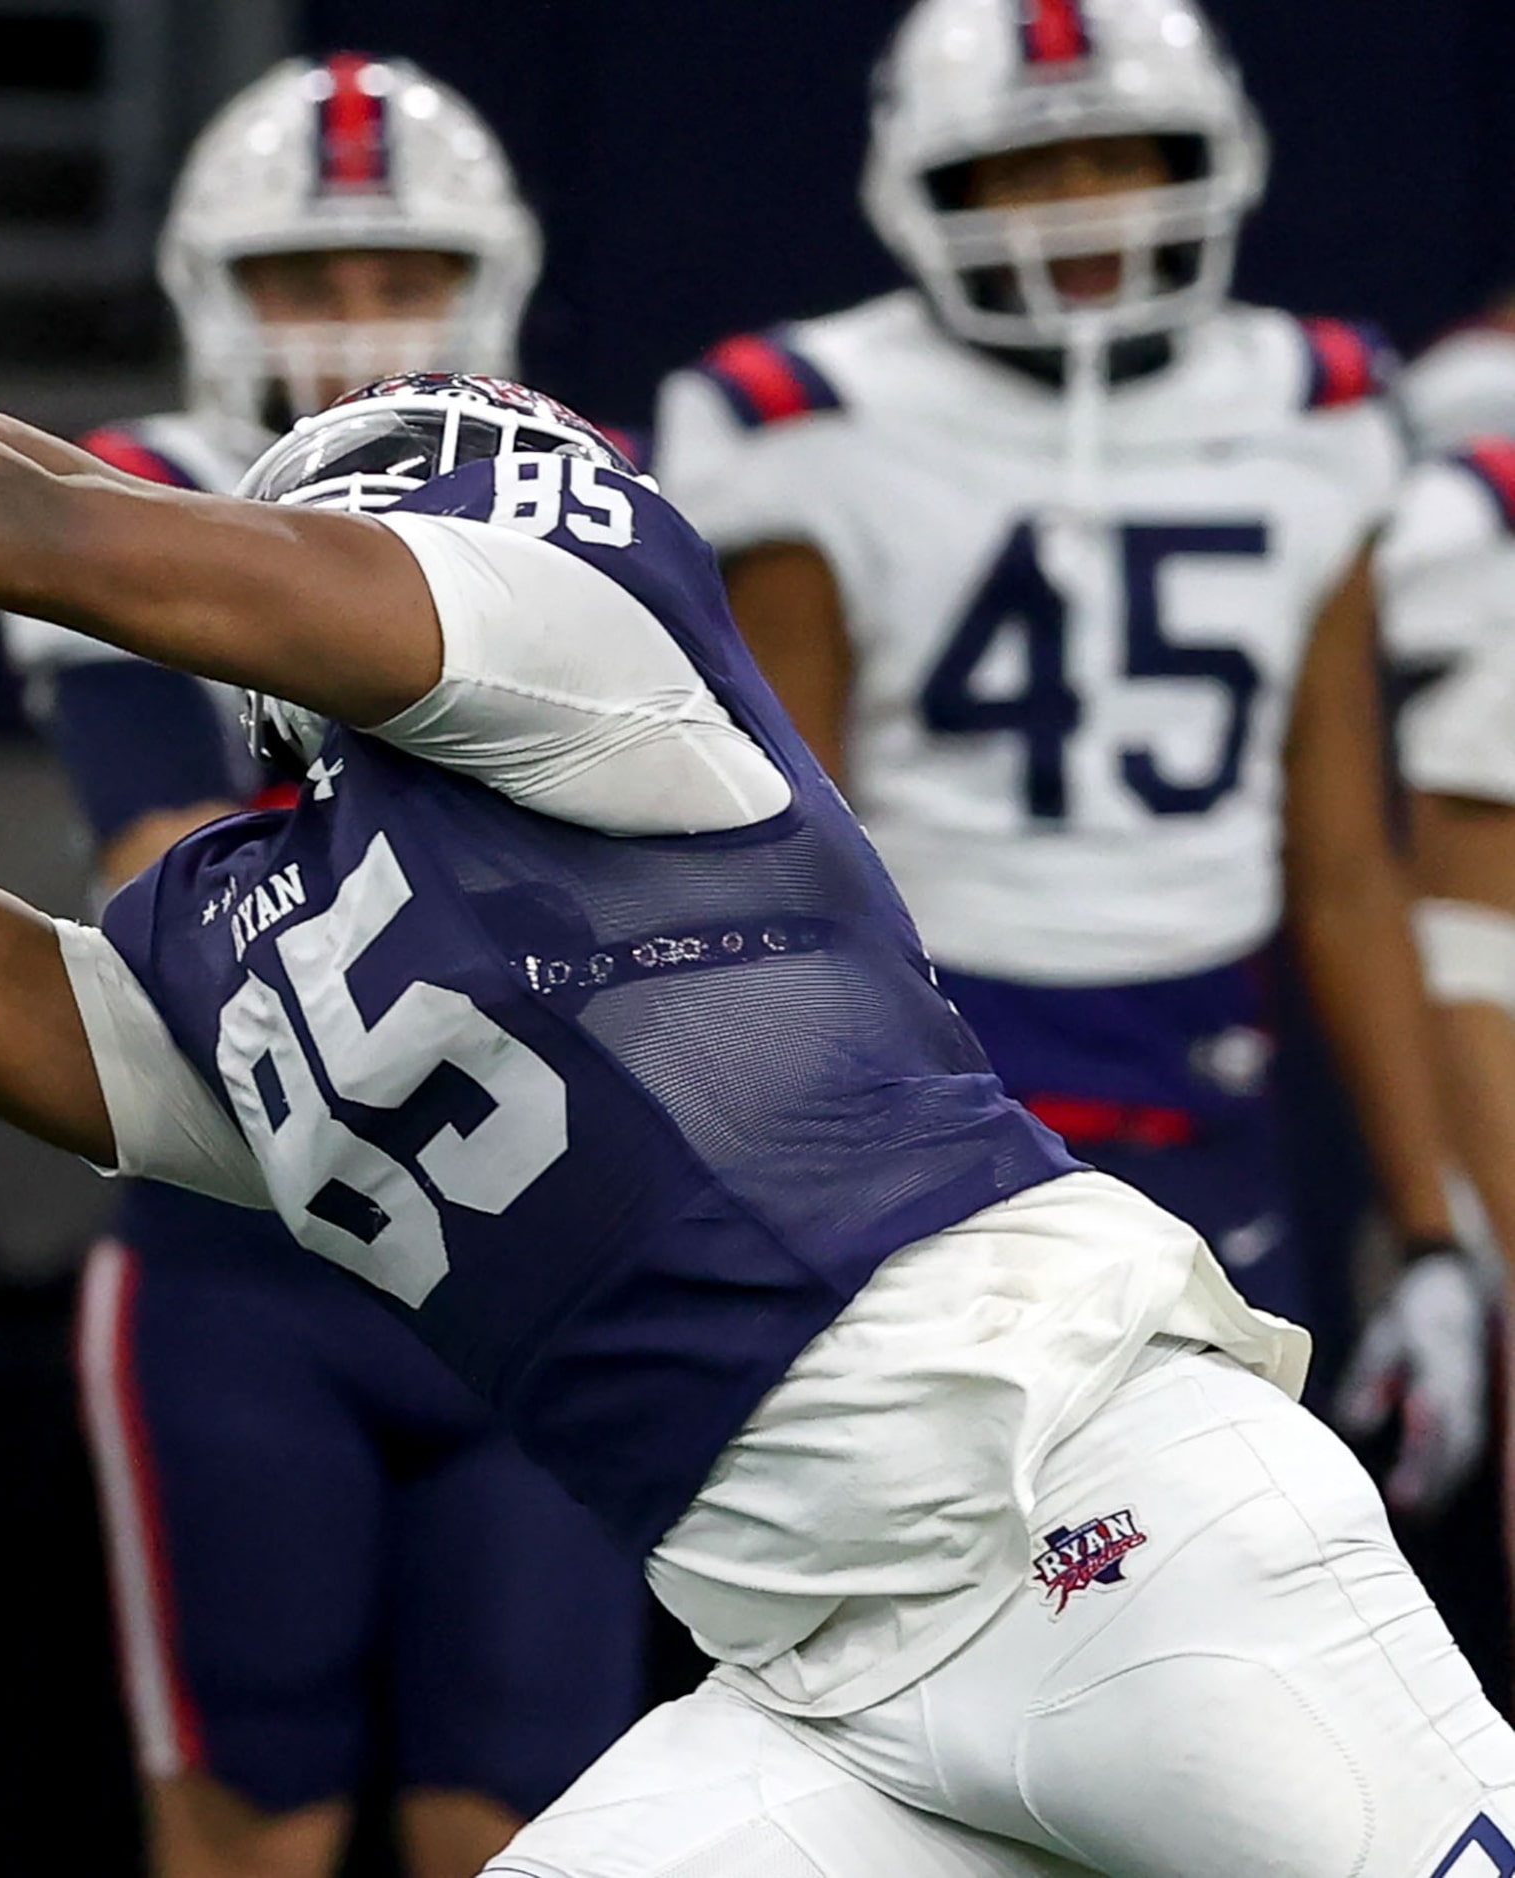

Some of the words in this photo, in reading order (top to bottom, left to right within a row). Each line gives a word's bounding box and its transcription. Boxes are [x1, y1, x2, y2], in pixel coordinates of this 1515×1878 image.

[488, 453, 634, 548] 85
[918, 514, 1268, 817] 45
[217, 831, 569, 1310] 85
[1035, 1511, 1138, 1584] RYAN
